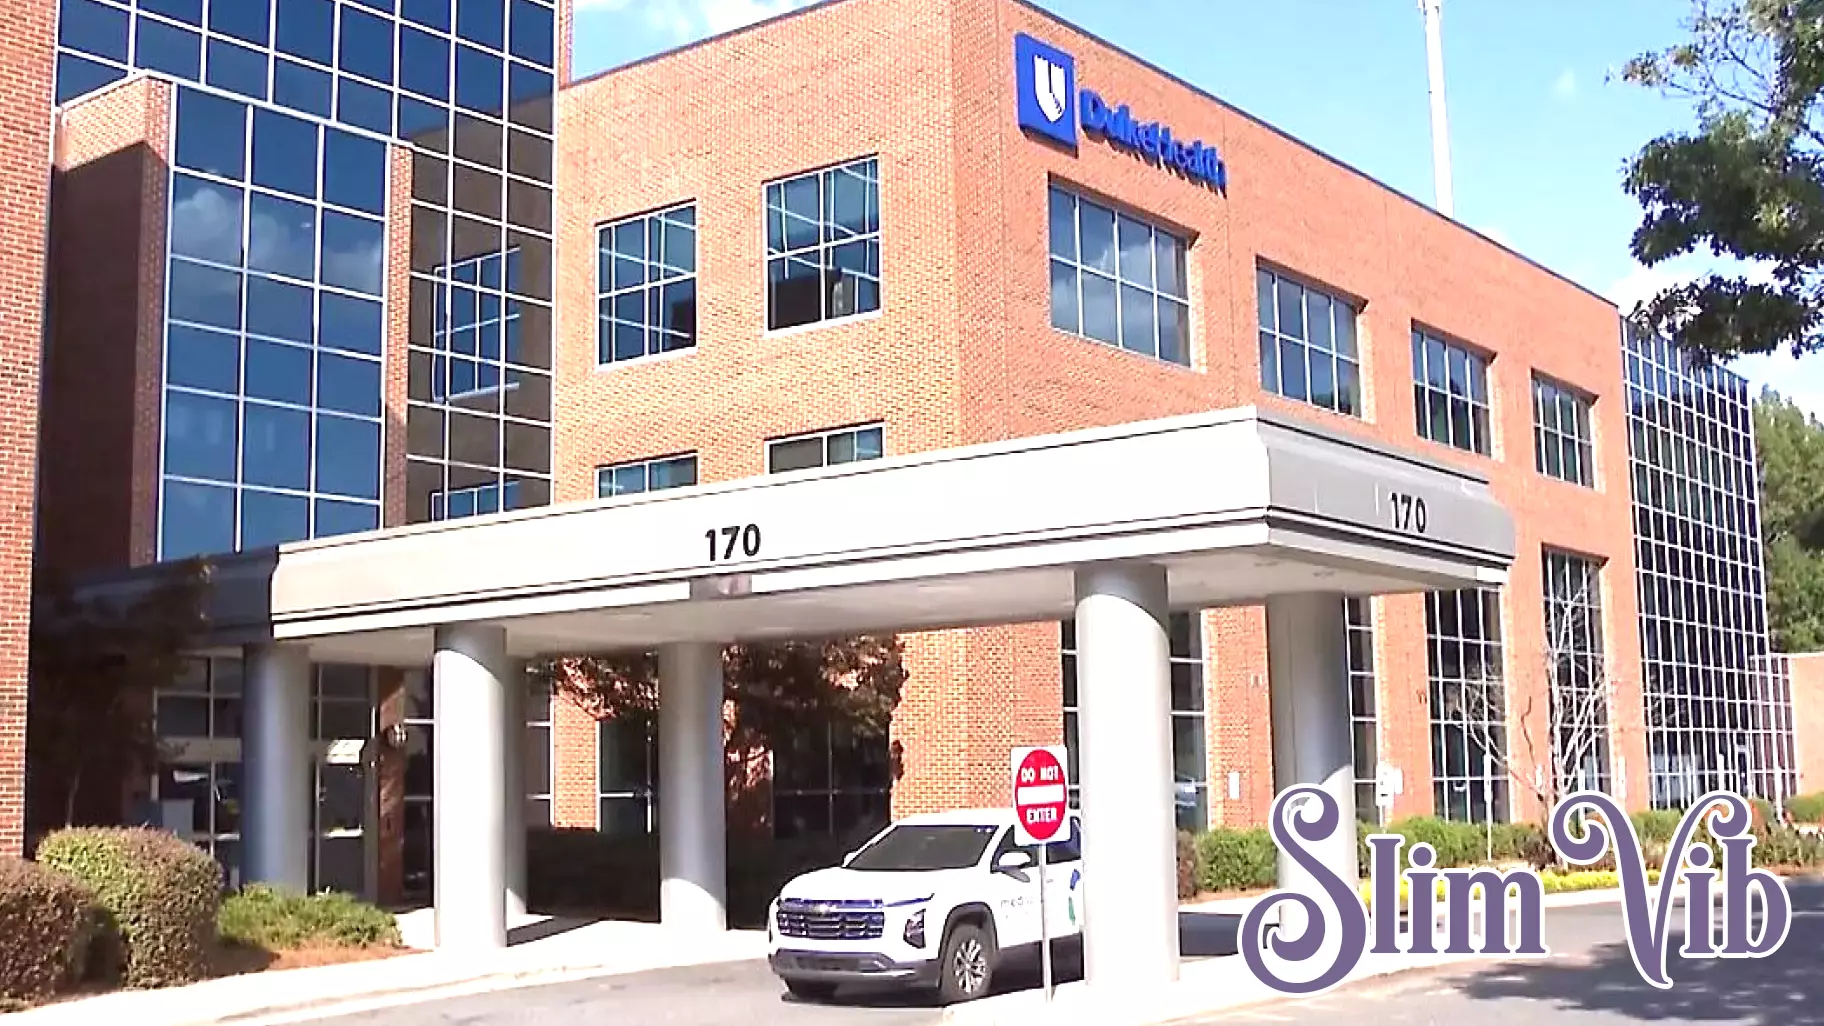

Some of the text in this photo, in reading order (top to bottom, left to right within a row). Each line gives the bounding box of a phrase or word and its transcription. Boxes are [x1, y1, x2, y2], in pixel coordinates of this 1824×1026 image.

[1389, 492, 1427, 534] 170
[705, 523, 761, 562] 170
[1021, 765, 1059, 783] DO NOT
[1026, 807, 1057, 824] ENTER
